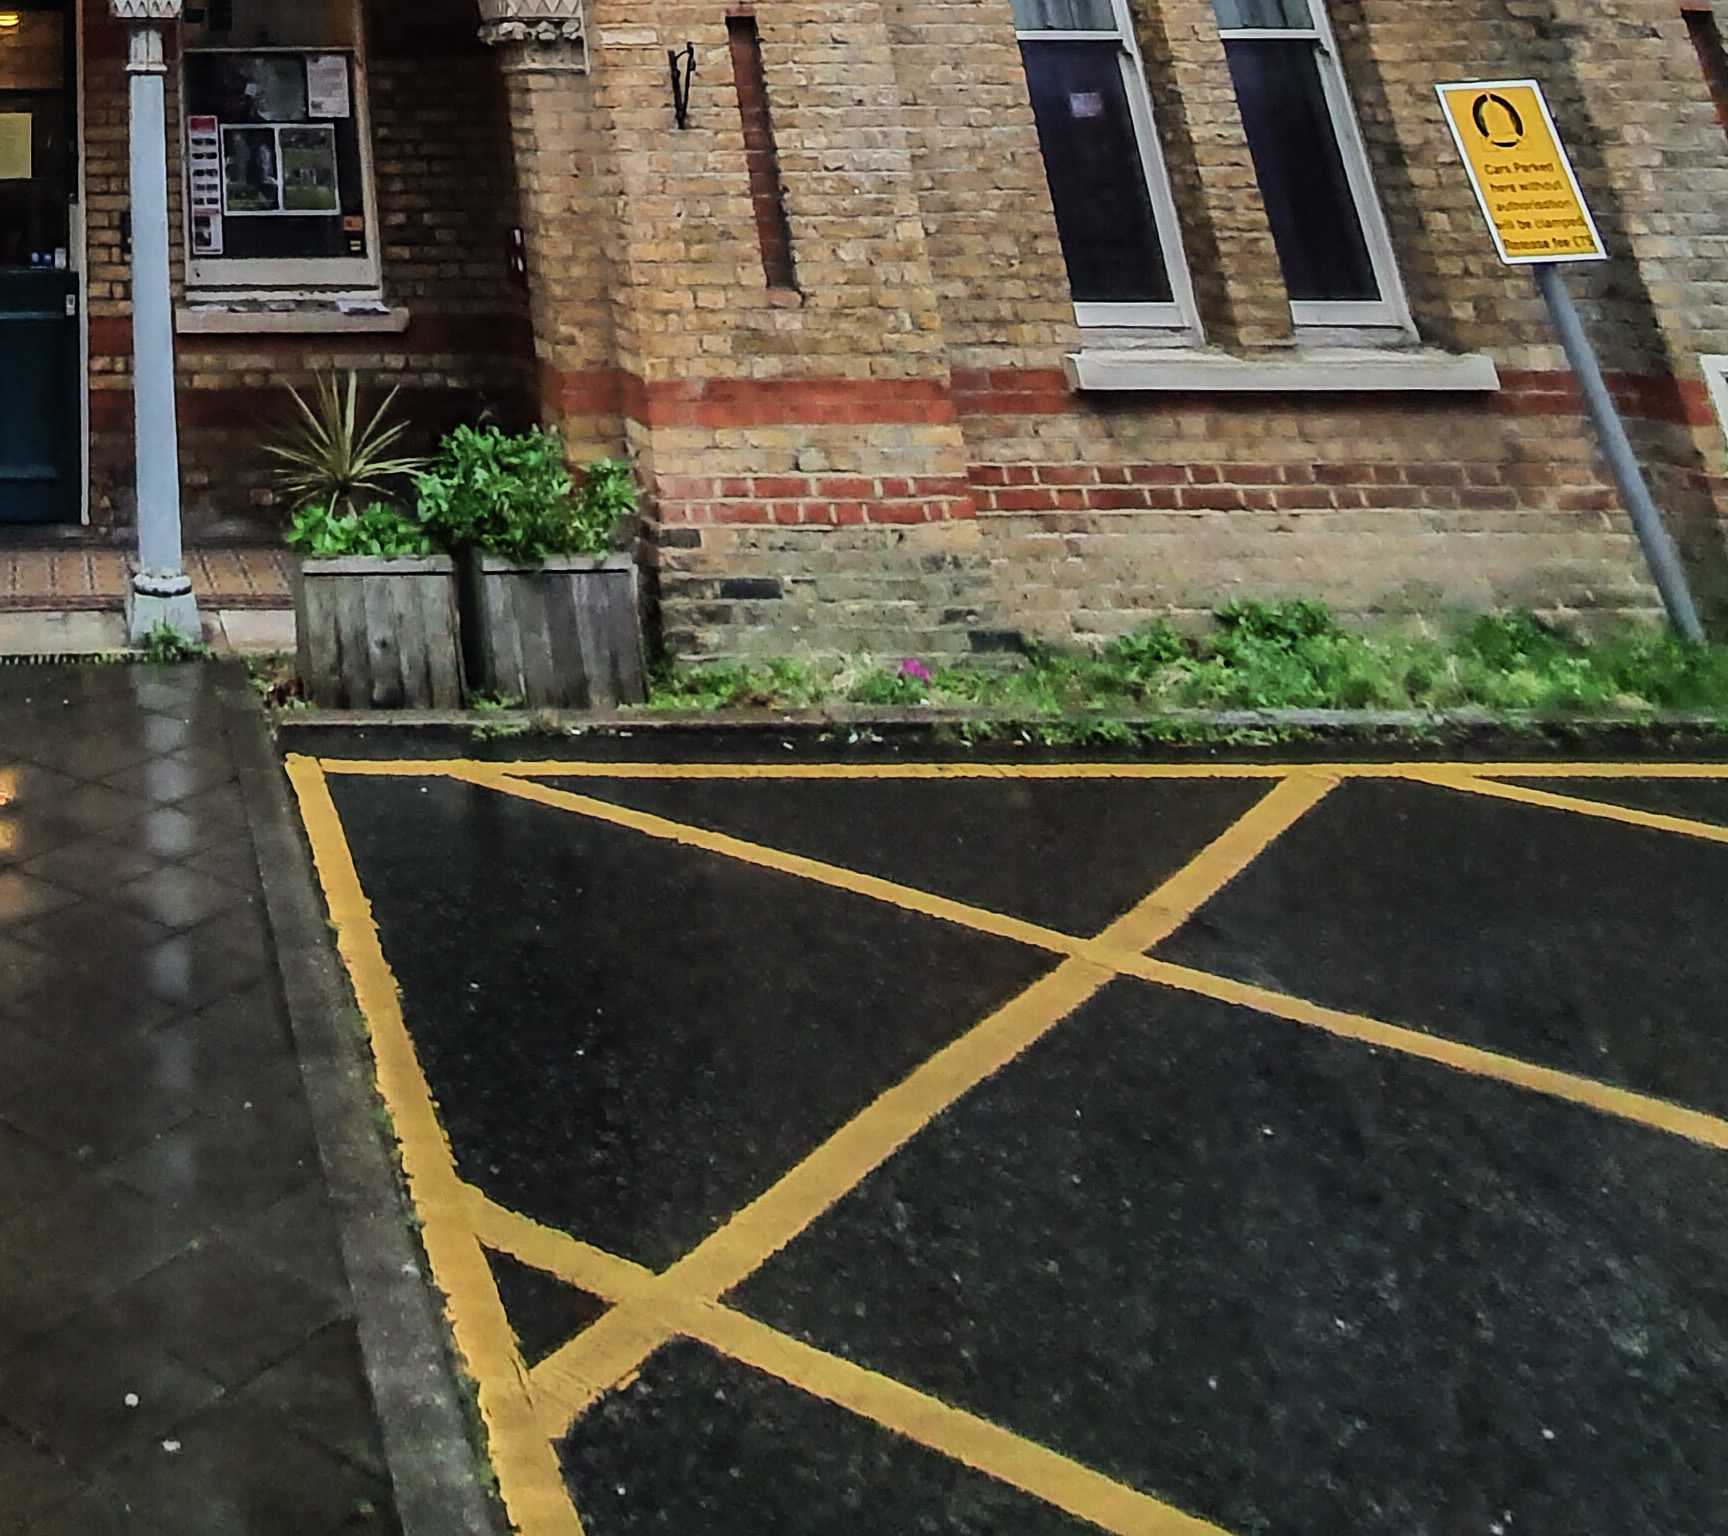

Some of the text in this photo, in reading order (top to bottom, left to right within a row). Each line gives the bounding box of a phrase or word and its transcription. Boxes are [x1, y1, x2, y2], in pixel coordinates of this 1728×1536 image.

[1513, 162, 1554, 173] Parked
[1519, 180, 1563, 191] without
[1517, 219, 1532, 230] be
